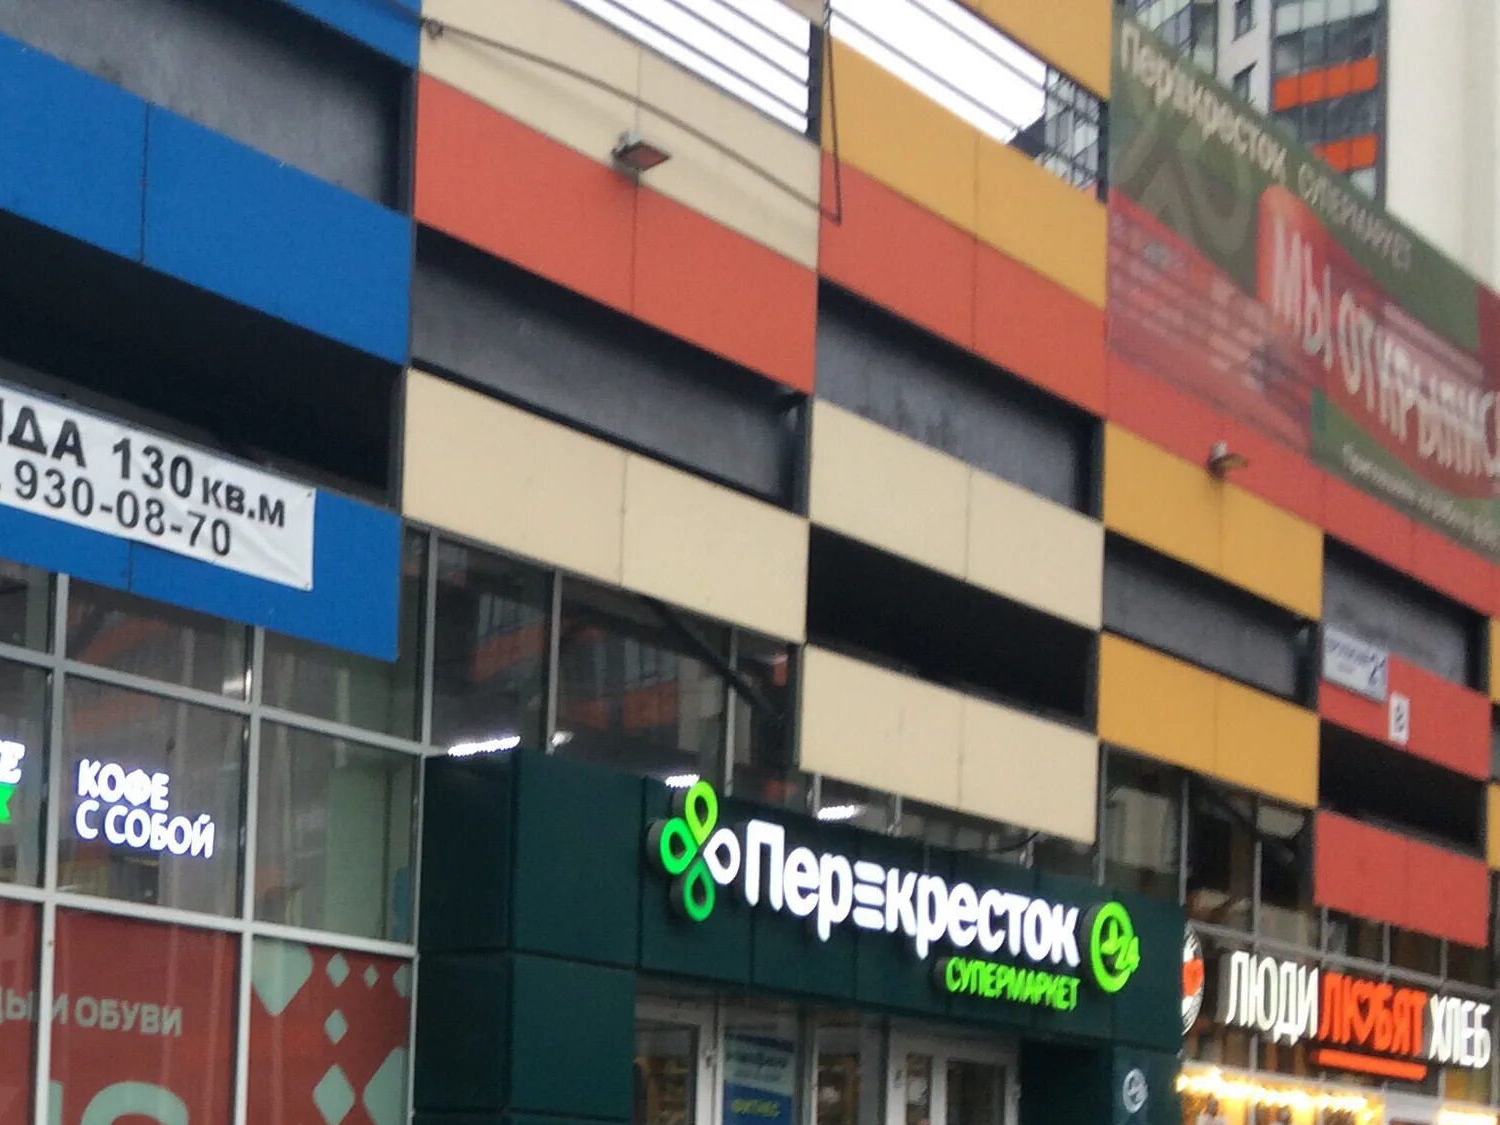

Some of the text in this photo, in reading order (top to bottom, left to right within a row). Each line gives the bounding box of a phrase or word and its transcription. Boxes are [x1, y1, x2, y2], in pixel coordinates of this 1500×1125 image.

[112, 437, 194, 499] 130
[14, 458, 233, 558] 930-08-70
[77, 758, 170, 811] КОФЕ
[75, 799, 216, 859] С СОБОЙ
[744, 818, 1081, 967] Перекресток
[944, 954, 1082, 1013] СУПЕРМАРКЕТ
[1225, 949, 1320, 1047] ЛЮДИ
[1428, 993, 1493, 1069] ХЛЕБ
[74, 995, 183, 1038] ОБУВИ
